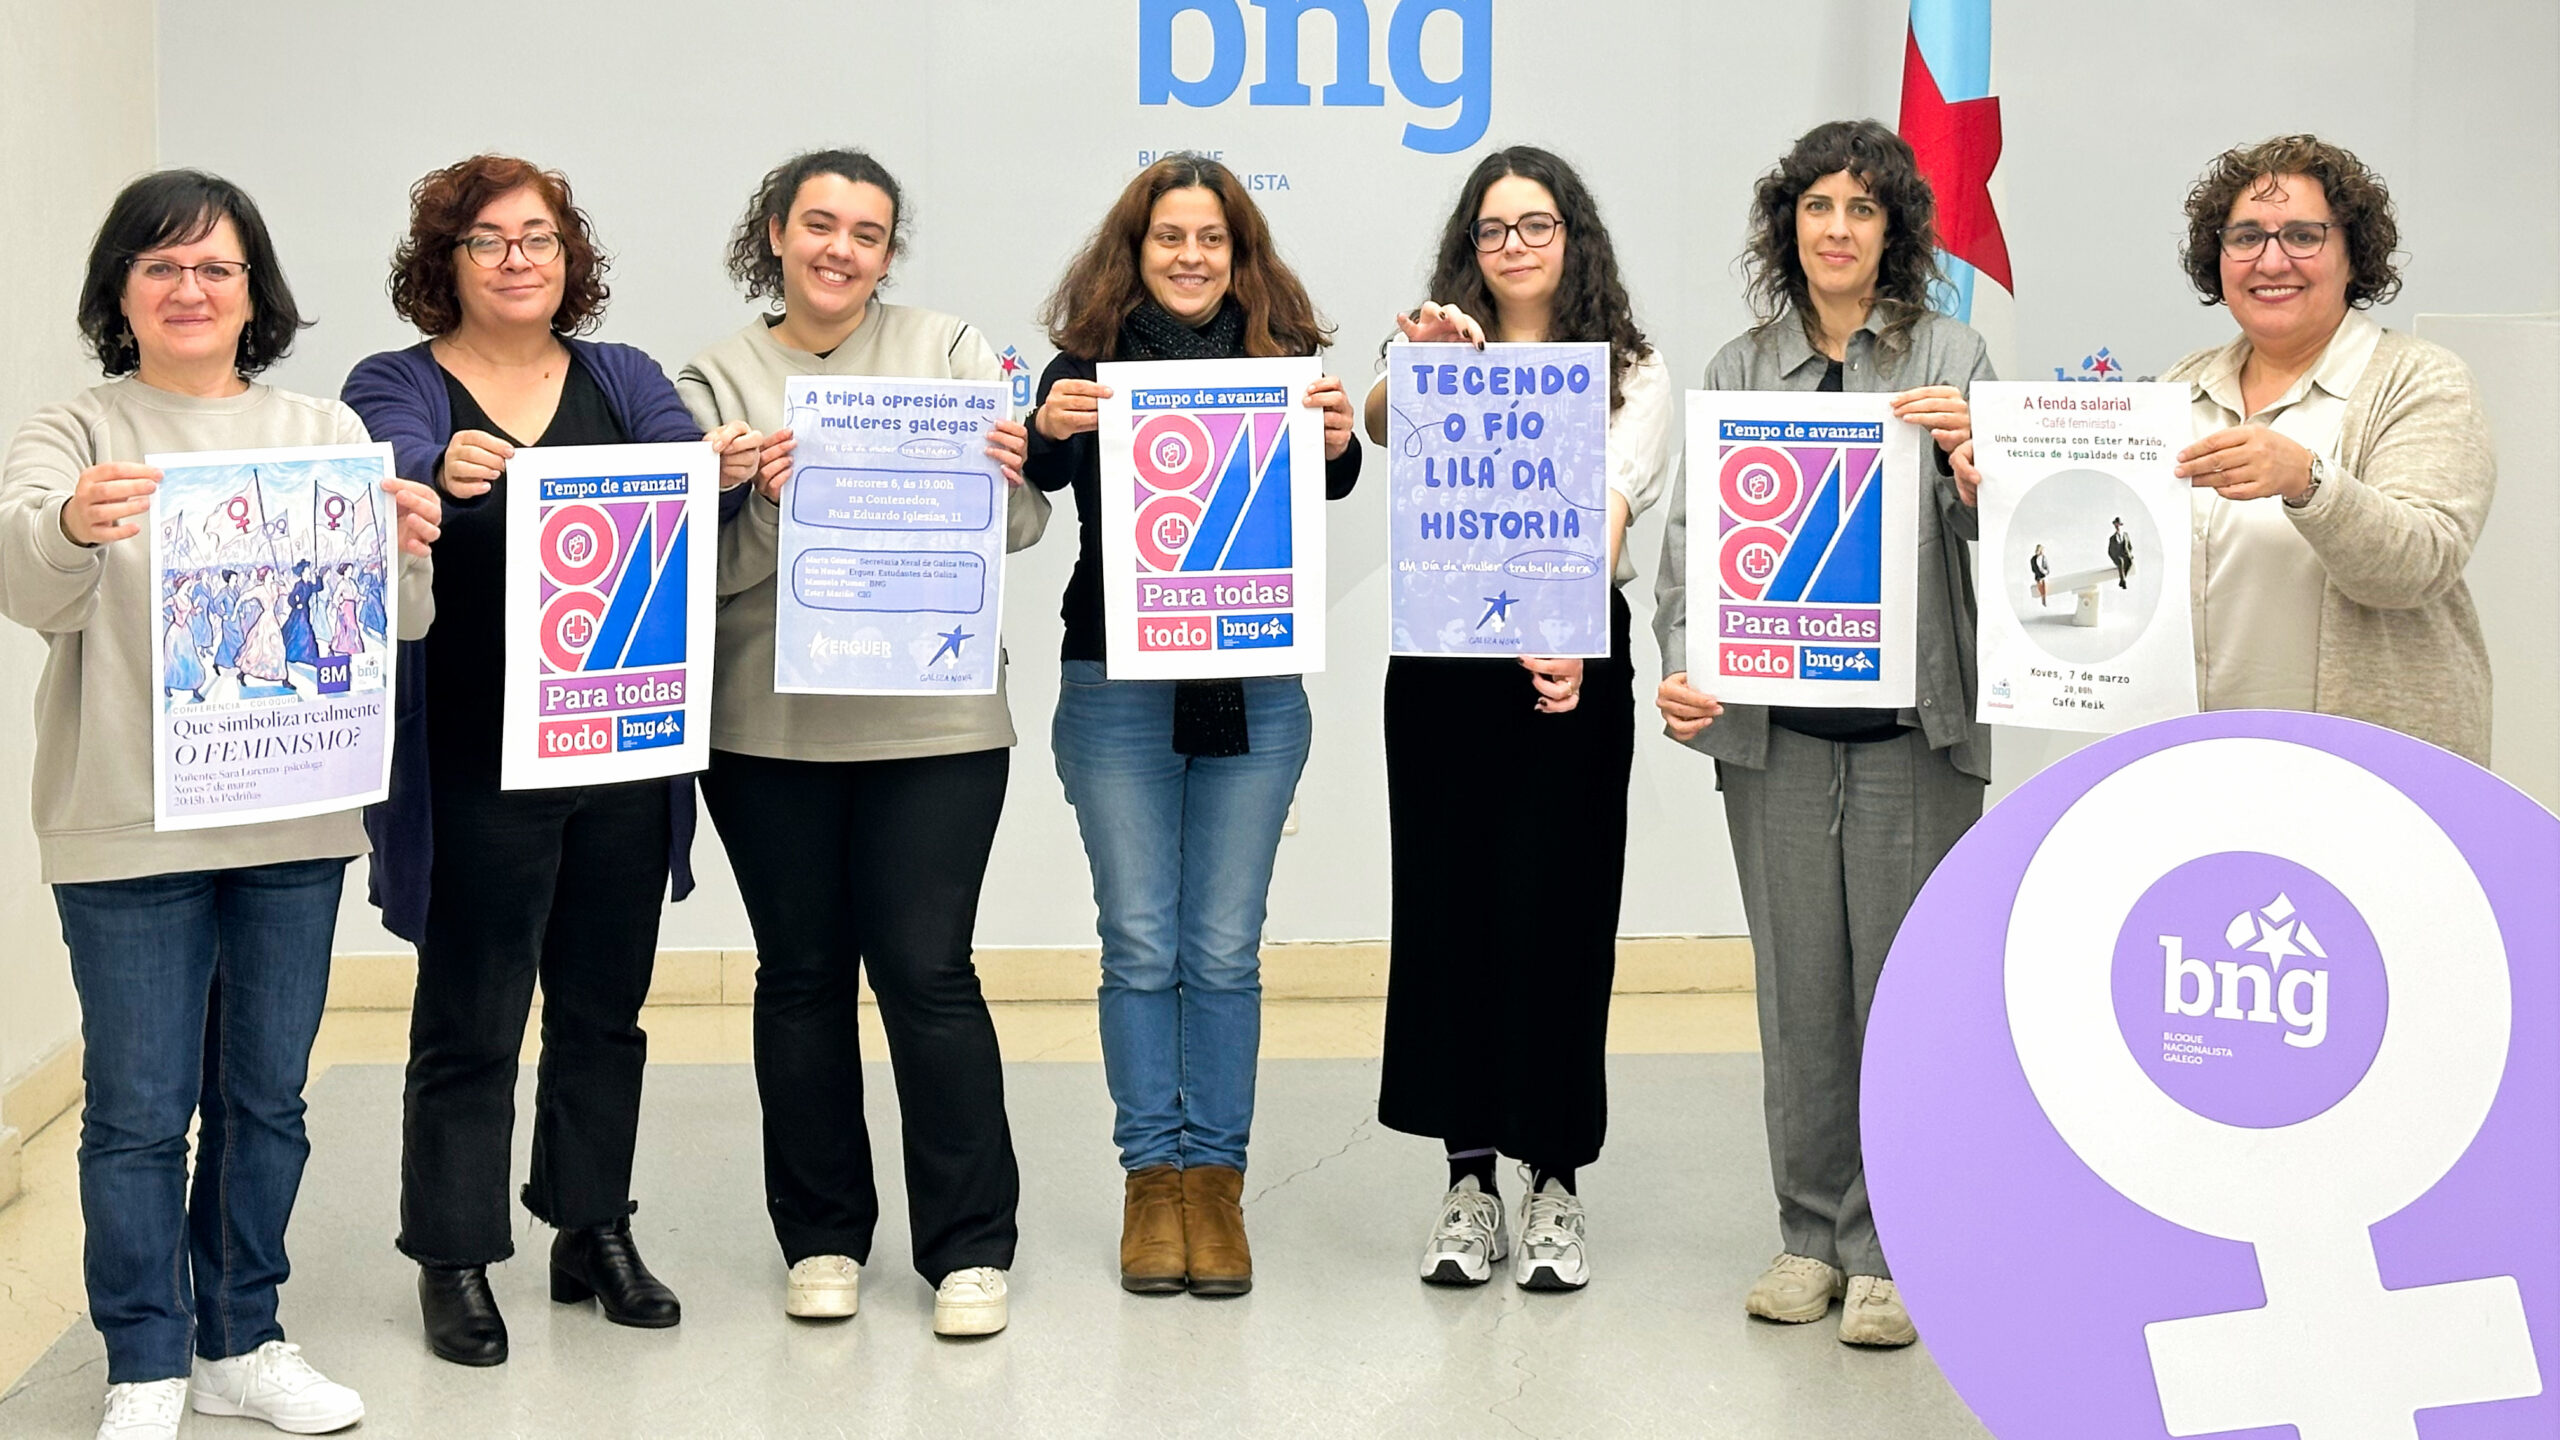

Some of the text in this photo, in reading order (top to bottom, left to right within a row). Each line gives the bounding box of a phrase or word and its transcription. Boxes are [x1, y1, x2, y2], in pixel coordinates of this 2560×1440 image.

[1139, 0, 1492, 154] bng
[1412, 364, 1590, 395] TECENDO
[806, 391, 995, 409] A tripla opresión das
[1135, 389, 1285, 408] Tempo de avanzar!
[2023, 396, 2131, 411] A fenda salarial
[821, 415, 978, 434] mulleres galegas
[1444, 399, 1544, 442] O FÍO
[2041, 417, 2066, 429] Café
[2068, 418, 2116, 429] feminista
[1723, 422, 1880, 440] Tempo de avanzar!
[1995, 435, 2017, 443] Unha
[2023, 436, 2067, 444] conversa
[2094, 437, 2123, 445] Ester
[2007, 449, 2157, 460] técnica de igualdade da CIG
[1425, 447, 1556, 491] LILÁ DA
[544, 475, 687, 499] Tempo de avanzar!
[835, 477, 954, 490] Mércores 6, ás 19.00h
[849, 494, 939, 507] na Contenedora,
[828, 509, 962, 523] Rúa Eduardo Iglesias, 11
[1421, 508, 1580, 540] HISTORIA
[1399, 560, 1591, 574] 8M Día da muller traballadora
[1142, 580, 1289, 607] Para todas
[1221, 618, 1260, 640] bng
[1725, 611, 1876, 638] Para todas
[1144, 623, 1207, 647] todo
[829, 639, 891, 659] ERGUER
[1726, 649, 1789, 674] todo
[1804, 649, 1843, 671] bng
[320, 665, 379, 683] 8M bng
[2070, 671, 2075, 679] 7
[2081, 672, 2093, 681] de
[2099, 675, 2130, 683] marzo
[546, 677, 683, 711] Para todas
[1992, 684, 2011, 698] bng
[173, 702, 240, 714] CONFERENCIA
[2053, 697, 2105, 710] Café Keik
[173, 702, 380, 739] Que simboliza realmente
[622, 718, 656, 739] bng
[175, 727, 361, 766] O FEMINISMO?
[546, 724, 607, 753] todo
[213, 782, 225, 791] de
[2158, 934, 2329, 1049] bng
[2163, 1032, 2204, 1044] BLOQUE
[2163, 1043, 2233, 1057] NACIONALISTA
[2163, 1053, 2203, 1065] GALEGO
